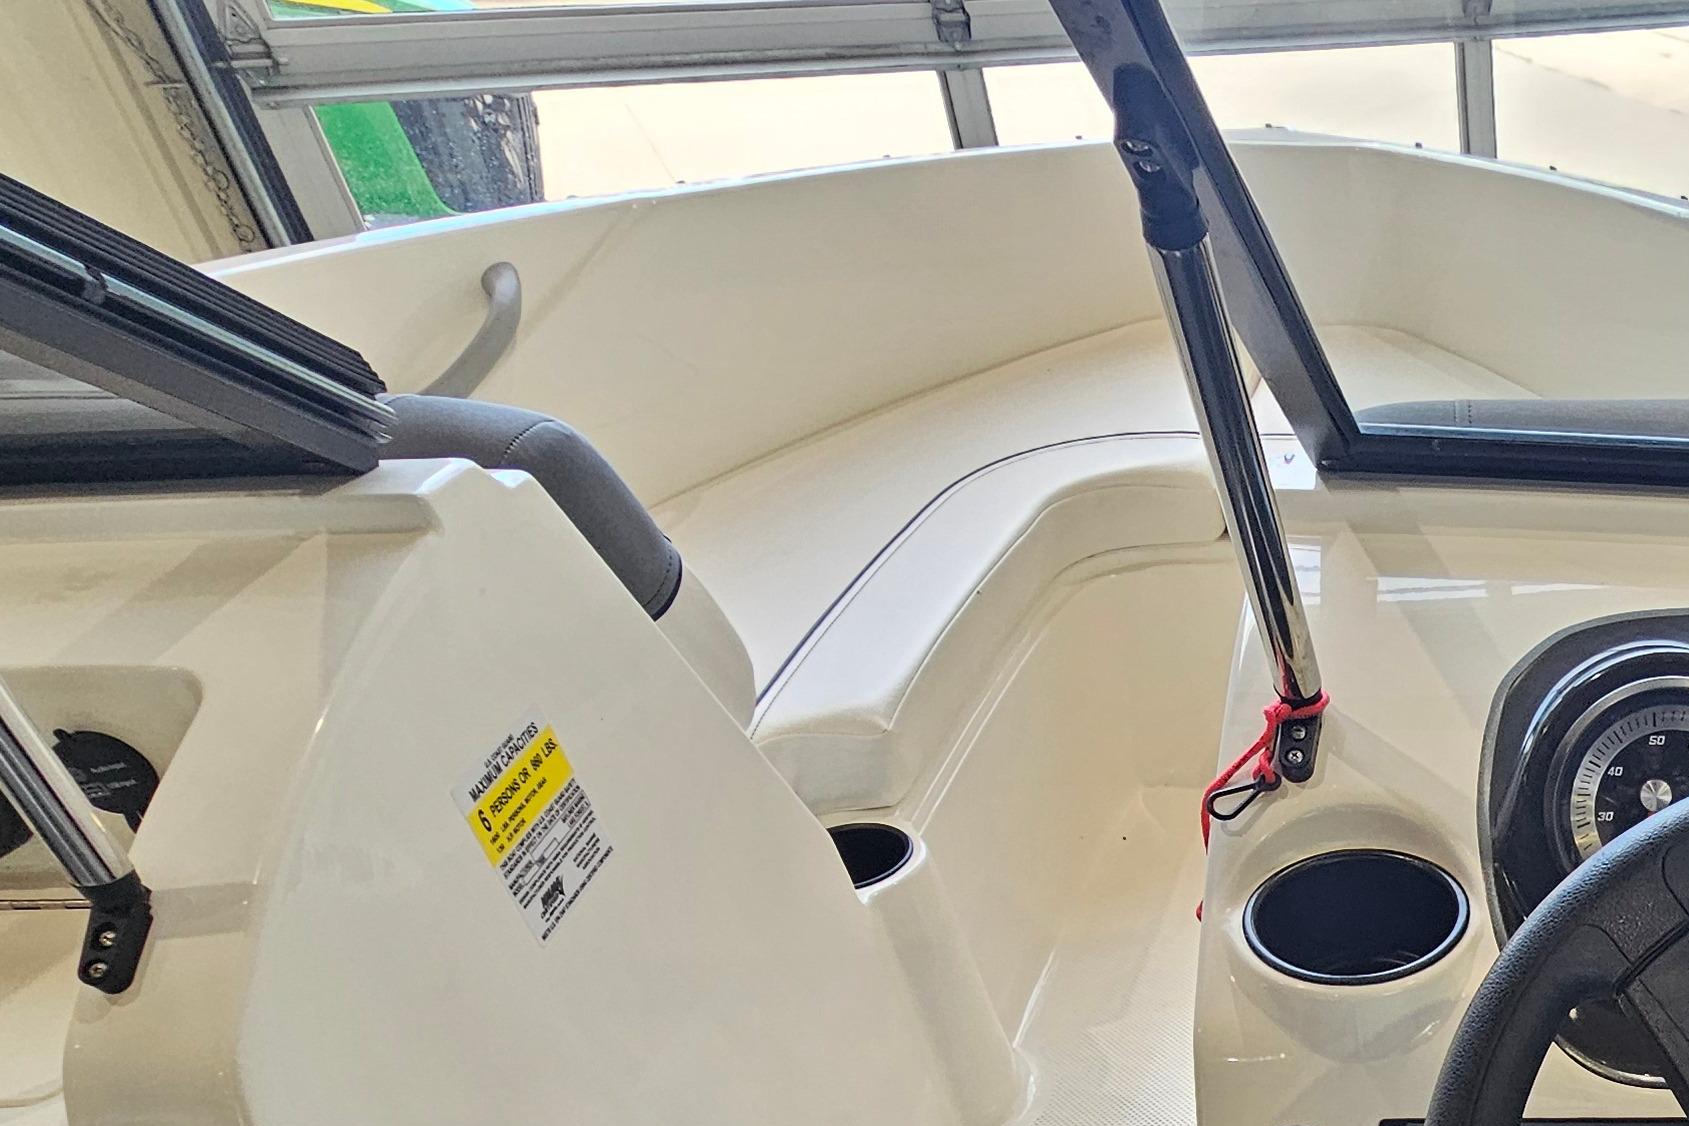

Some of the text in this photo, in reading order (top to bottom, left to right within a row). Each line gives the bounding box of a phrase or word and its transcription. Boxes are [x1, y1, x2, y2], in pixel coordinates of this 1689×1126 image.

[1648, 735, 1666, 746] 50
[468, 761, 503, 802] MAXIMUM
[502, 722, 539, 768] CAPACITIES
[1607, 766, 1624, 777] 40
[477, 808, 493, 833] 6
[488, 775, 521, 817] PERSONS
[516, 766, 531, 785] OR
[1597, 811, 1614, 822] 30
